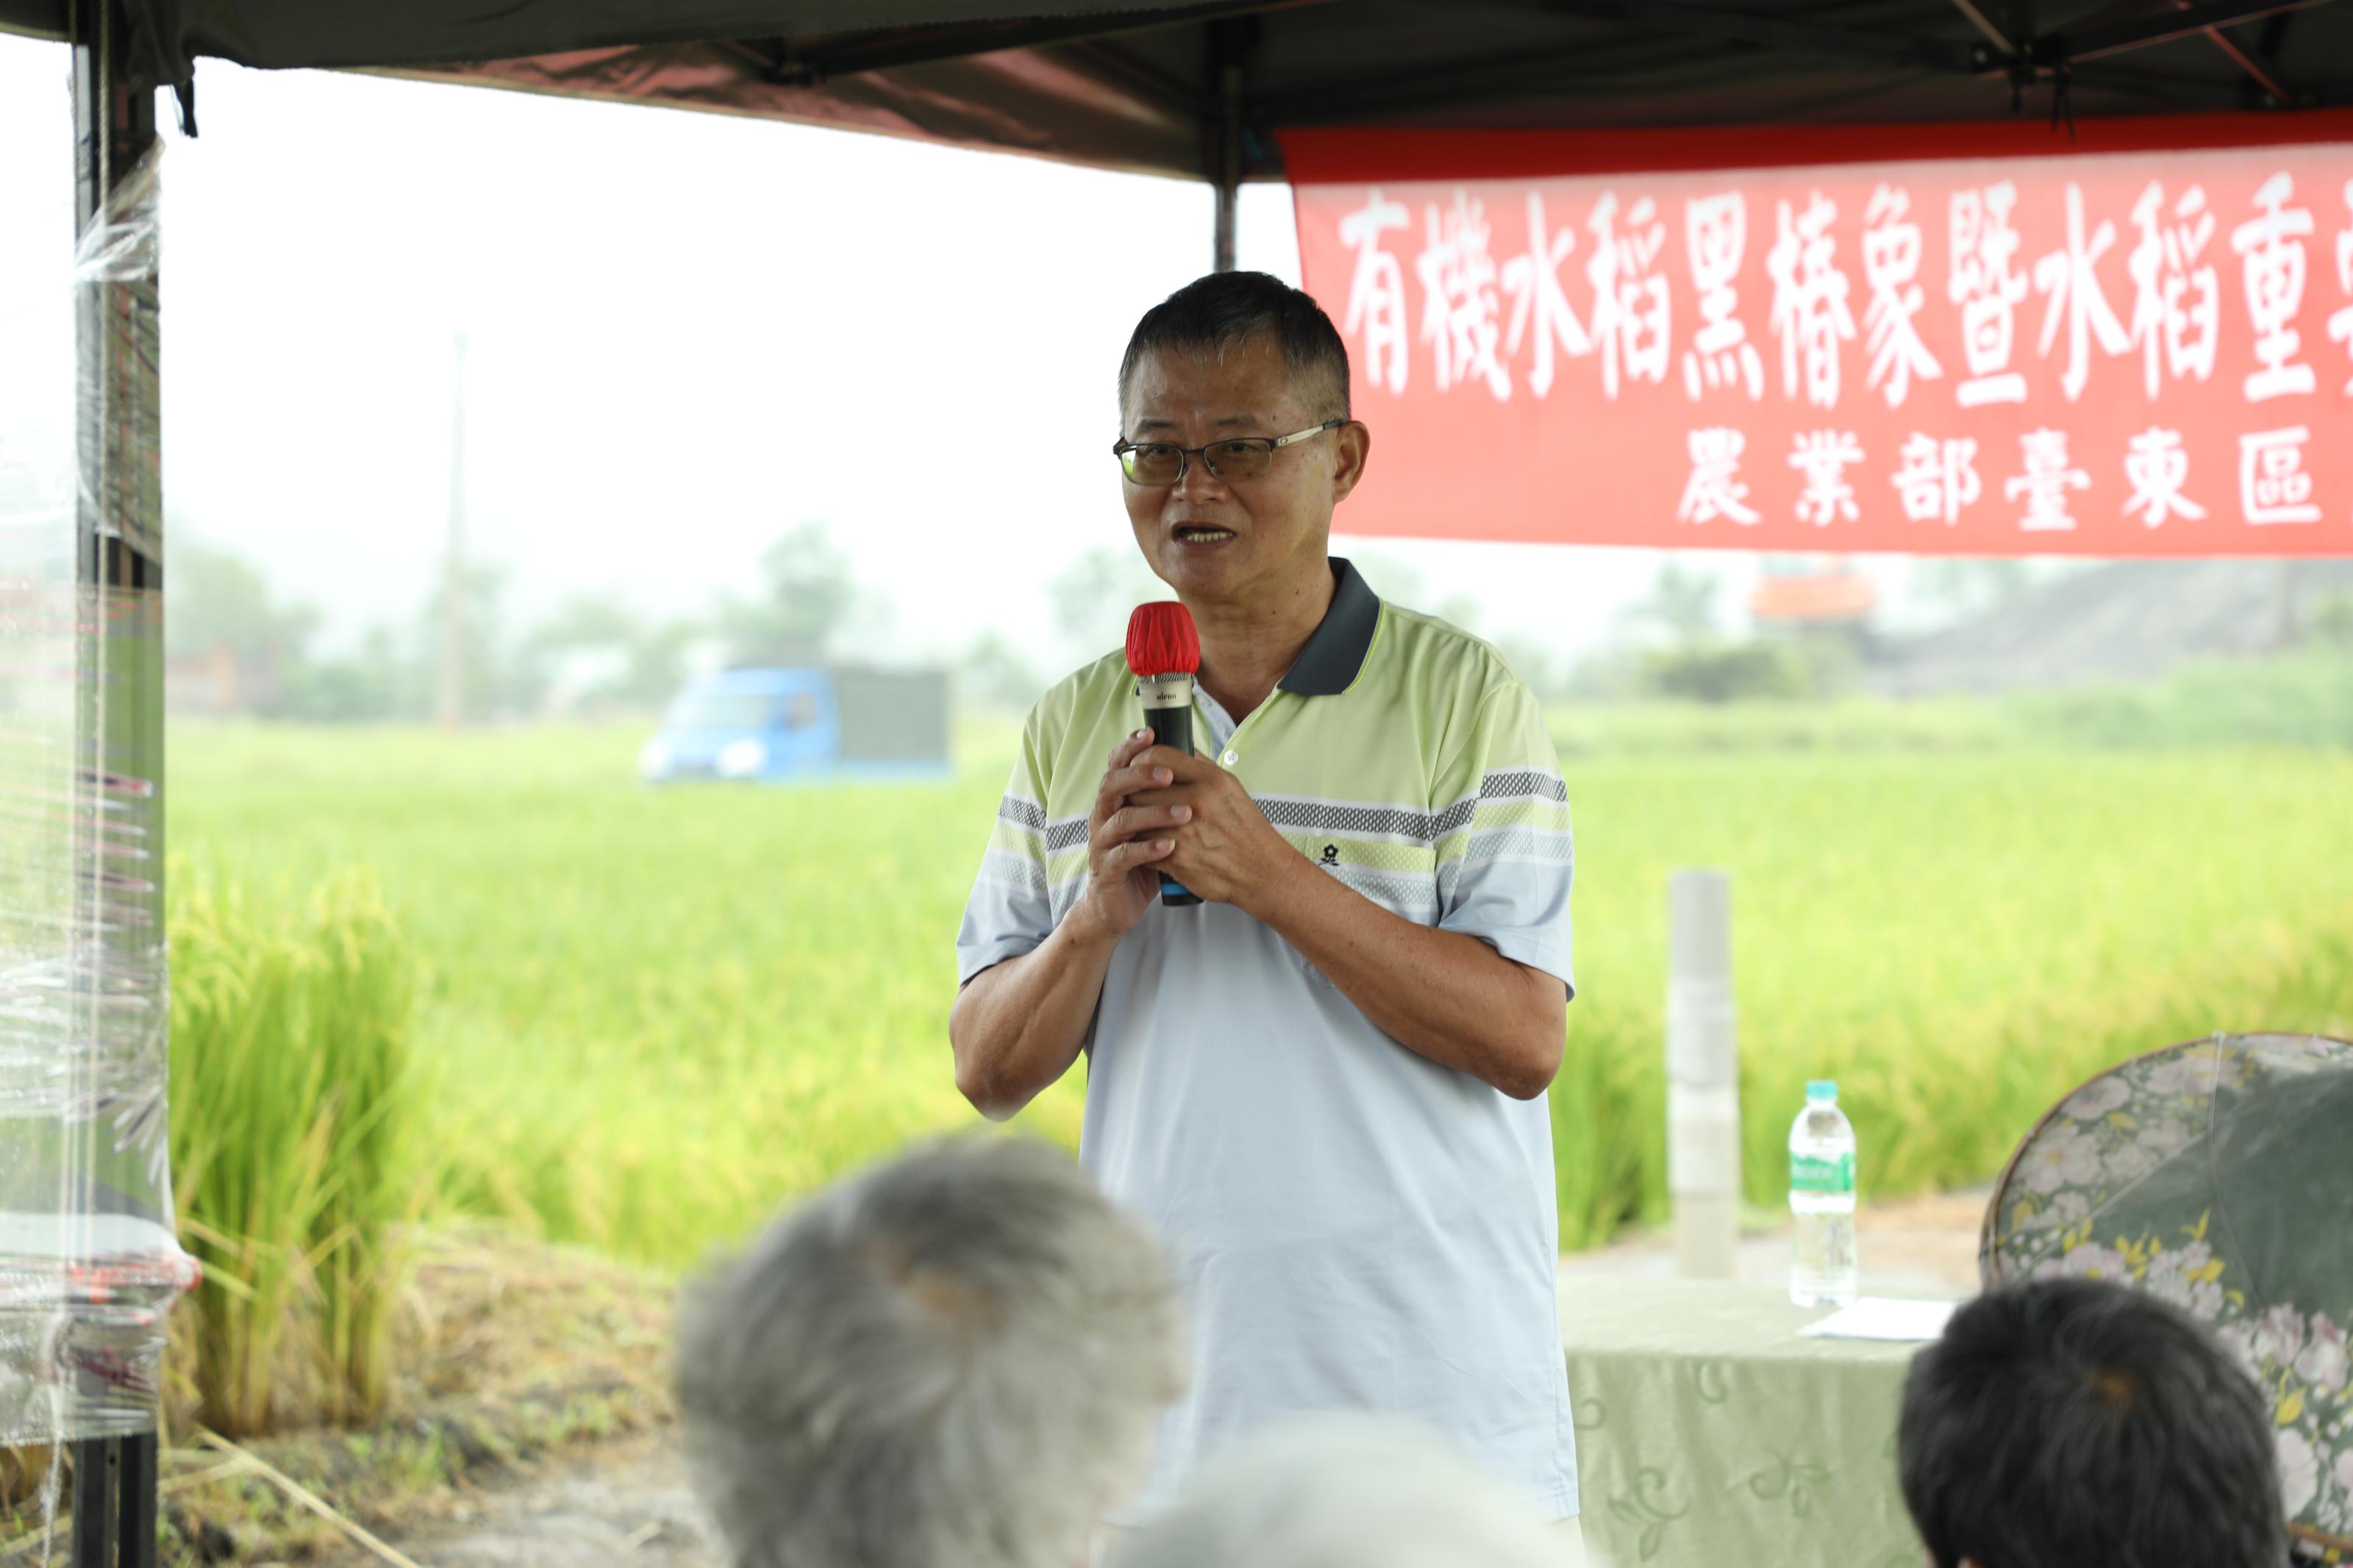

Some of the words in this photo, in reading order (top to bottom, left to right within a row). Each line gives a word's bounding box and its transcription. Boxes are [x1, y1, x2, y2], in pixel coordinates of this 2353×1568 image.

[1338, 171, 2353, 406] 有機水稻黑椿象暨水稻重
[1679, 425, 2322, 531] 農業部臺東區
